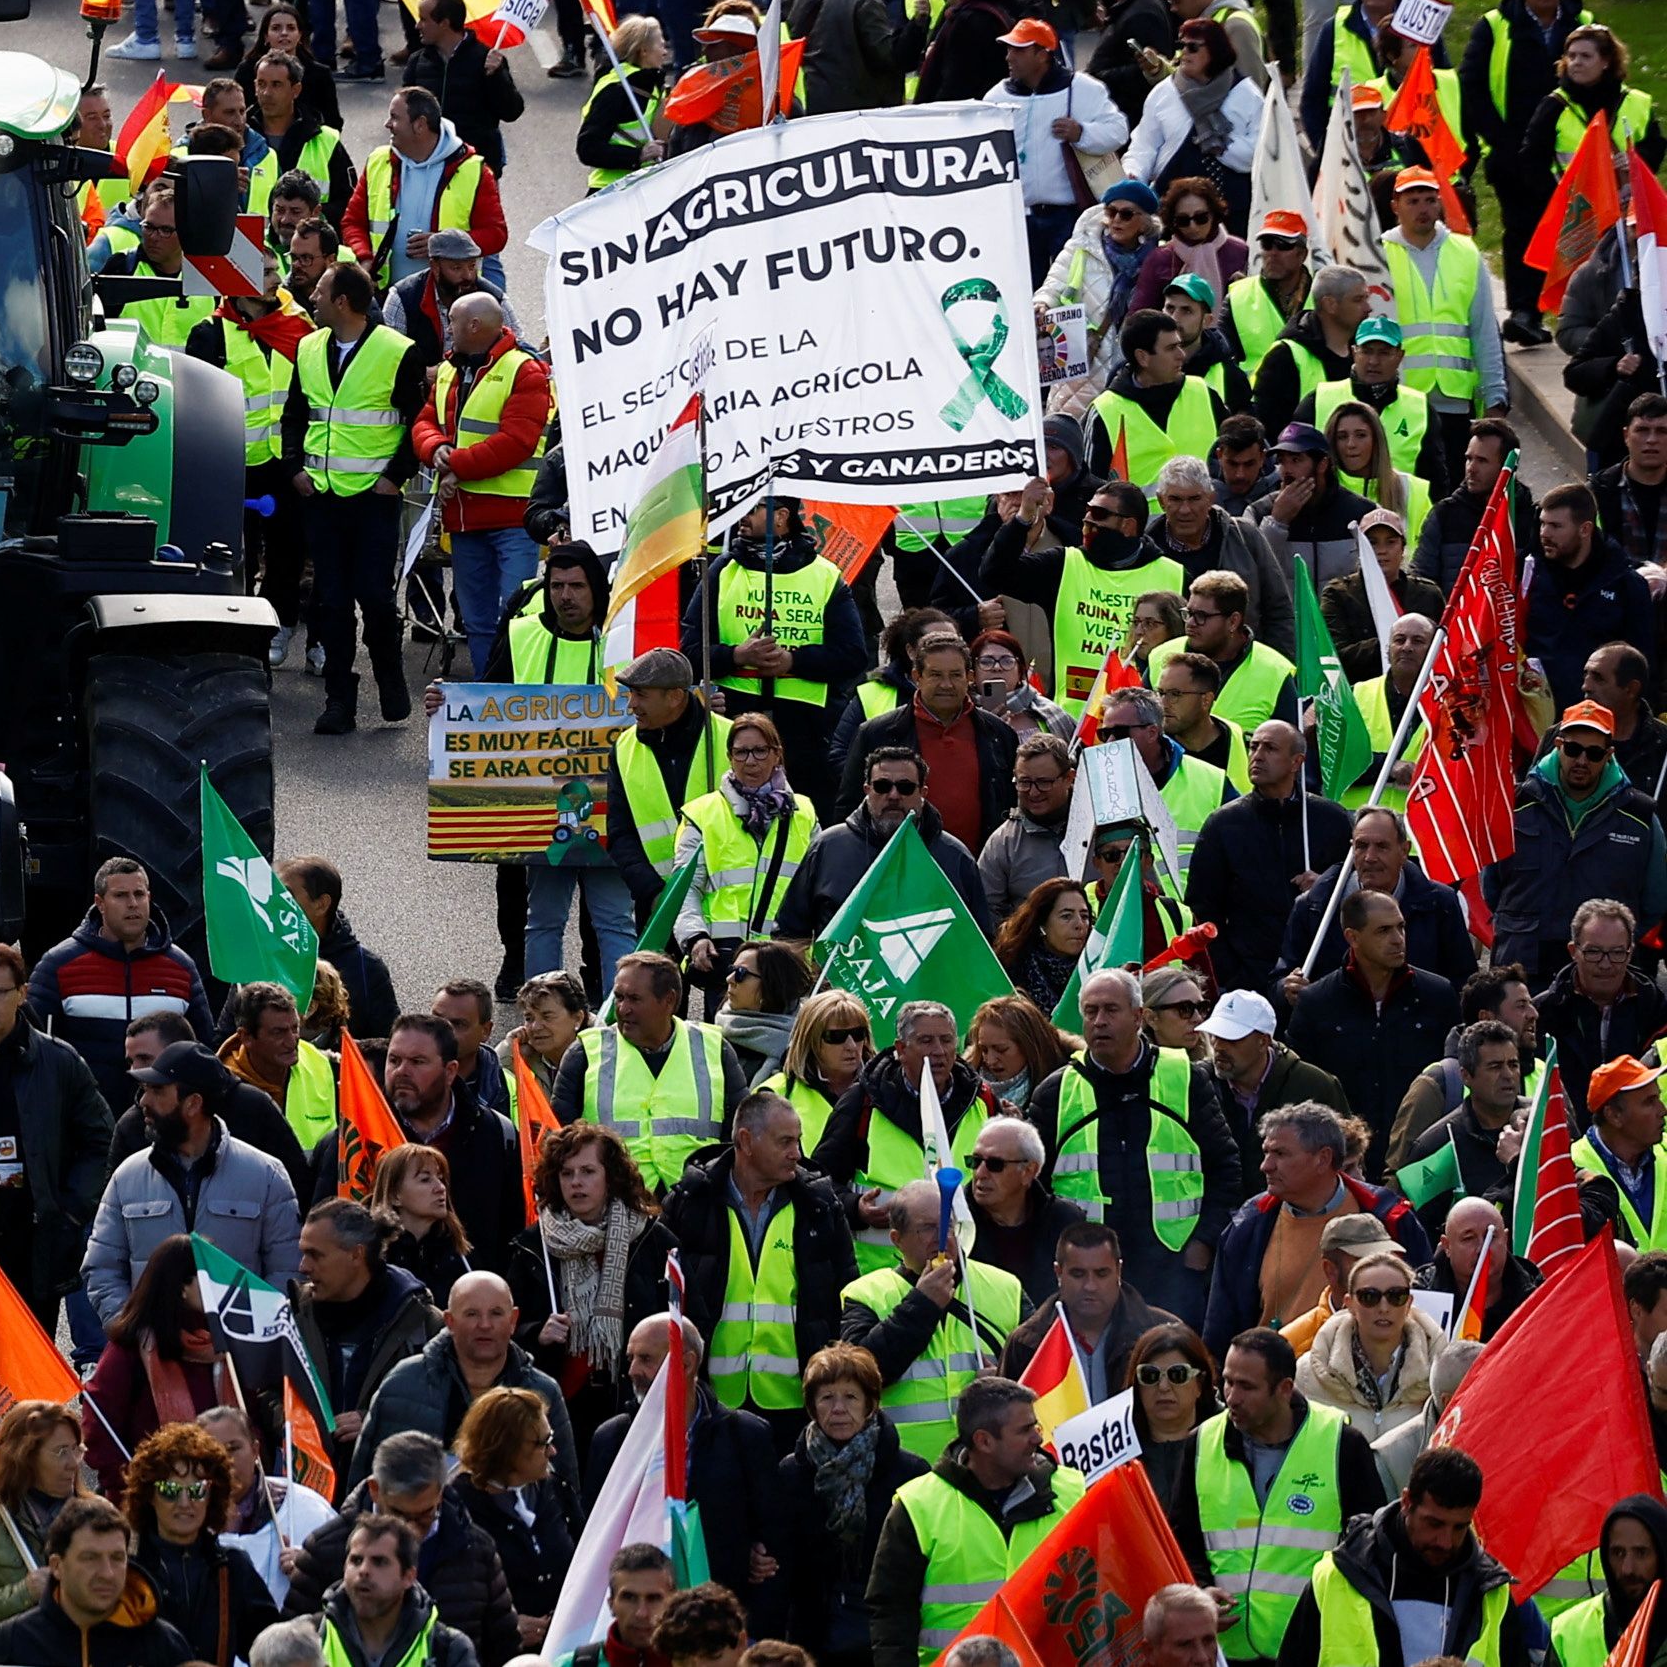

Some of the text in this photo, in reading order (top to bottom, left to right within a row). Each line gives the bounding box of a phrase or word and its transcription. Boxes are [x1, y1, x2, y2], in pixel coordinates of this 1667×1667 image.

[560, 139, 1015, 286] SIN AGRICULTURA,
[572, 226, 981, 364] NO HAY FUTURO.
[1055, 308, 1083, 321] TIRANO
[583, 405, 615, 430] EL
[725, 335, 768, 361] DE
[779, 330, 818, 354] LA
[1067, 361, 1087, 375] 2030
[770, 357, 924, 408] AGRÍCOLA
[761, 410, 915, 455] NUESTROS
[808, 458, 832, 475] Y
[852, 445, 1035, 478] GANADEROS
[747, 589, 814, 606] NUSTRA
[1089, 587, 1135, 608] NUEST
[785, 608, 824, 625] SERÁ
[1077, 601, 1120, 625] RUINA
[744, 623, 810, 641] VSTRA
[1085, 621, 1128, 641] VUEST
[446, 694, 635, 722] LA AGRICULT
[445, 727, 599, 752] ES MUY FÁCIL
[1096, 741, 1120, 758] NO
[449, 760, 475, 778] SE
[483, 760, 531, 778] ARA
[538, 756, 589, 776] CON
[839, 934, 897, 1020] SAJA
[1061, 1405, 1133, 1475] Basta!
